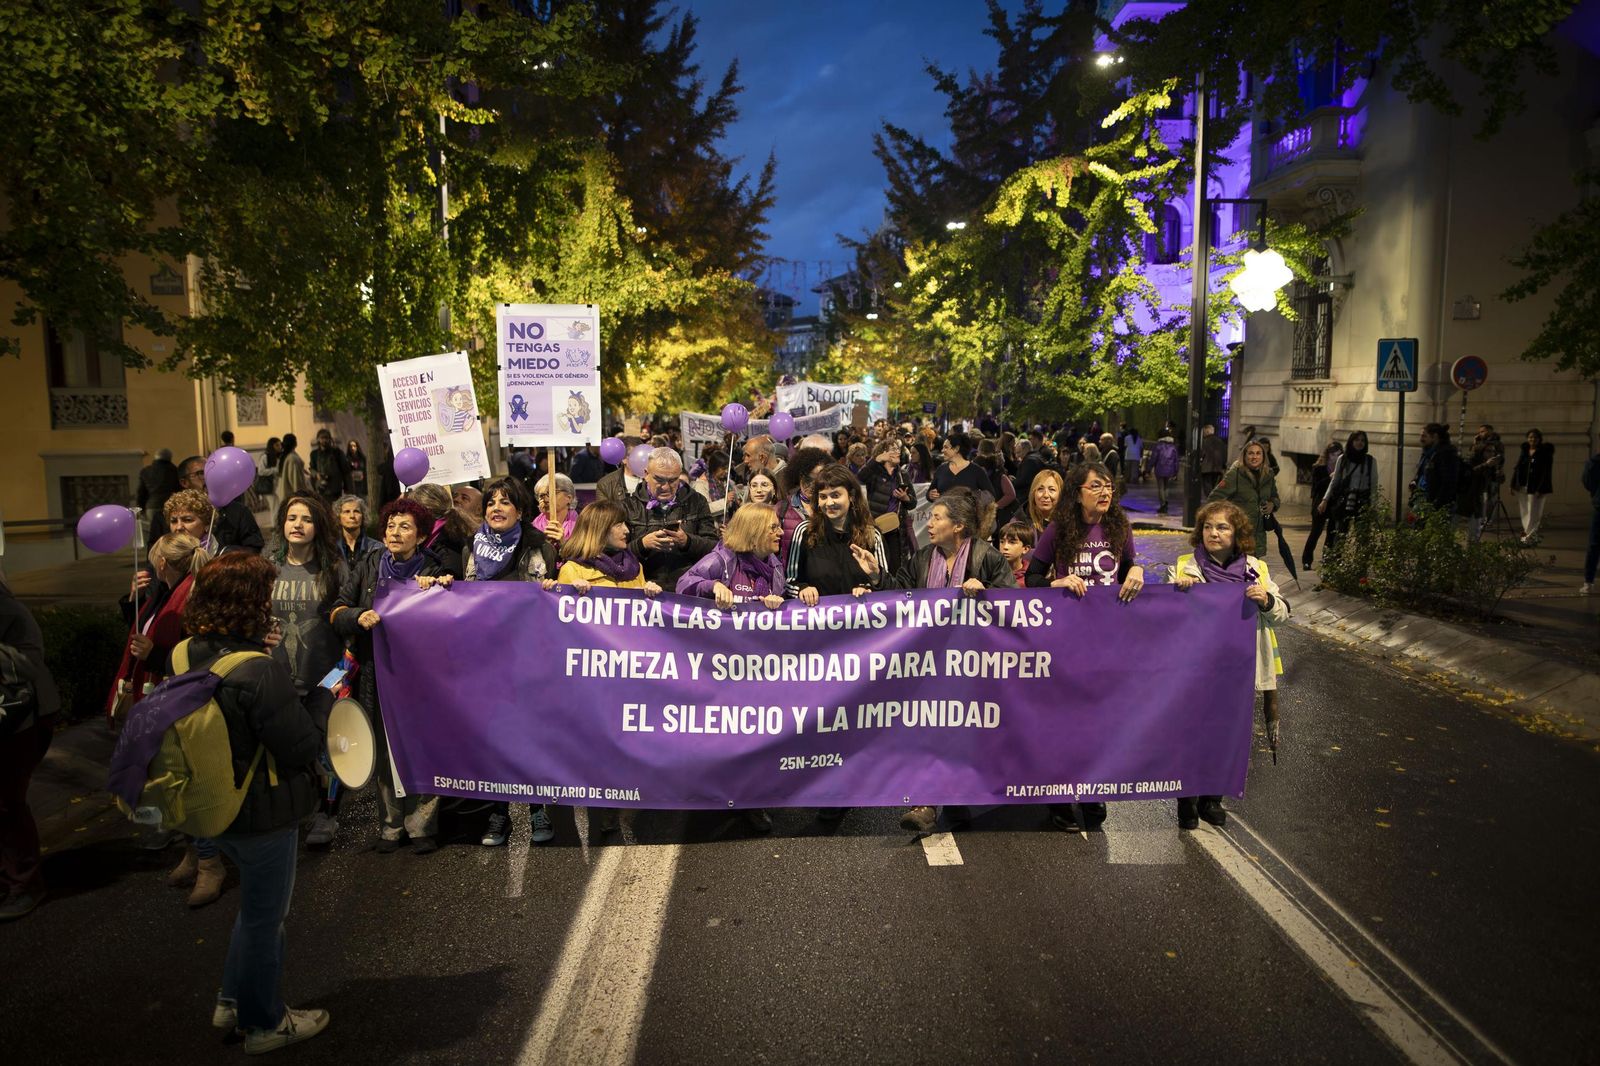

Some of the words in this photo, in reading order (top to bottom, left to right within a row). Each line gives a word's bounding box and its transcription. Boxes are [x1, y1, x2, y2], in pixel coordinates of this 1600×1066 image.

[509, 322, 544, 339] NO
[506, 343, 560, 352] TENGAS
[508, 358, 560, 369] MIEDO
[392, 374, 419, 389] ACCESO
[419, 370, 434, 384] EN
[394, 389, 407, 401] LSE
[408, 388, 415, 398] A
[414, 386, 428, 398] LOS
[396, 397, 432, 413] SERVICIOS
[401, 425, 411, 437] DE
[404, 432, 438, 449] ATENCIÓN
[422, 444, 445, 457] MUJER
[558, 596, 665, 628] CONTRA
[673, 604, 722, 630] LAS
[732, 602, 888, 631] VIOLENCIAS
[895, 598, 1053, 628] MACHISTAS:
[566, 648, 679, 680] FIRMEZA
[687, 652, 704, 680] Y
[711, 653, 861, 682] SORORIDAD
[869, 650, 937, 681] PARA
[945, 649, 1052, 679] ROMPER
[622, 703, 655, 732] EL
[662, 704, 783, 735] SILENCIO
[791, 706, 810, 734] Y
[817, 706, 849, 733] LA
[856, 700, 1001, 729] IMPUNIDAD
[779, 753, 843, 770] 25N-2024
[434, 776, 476, 791] ESPACIO
[478, 780, 534, 796] FEMINISMO
[536, 786, 586, 799] UNITARIO
[588, 787, 602, 799] DE
[604, 788, 641, 801] GRANÁ
[1006, 783, 1074, 797] PLATAFORMA
[1076, 782, 1118, 796] 8M/25N
[1120, 782, 1133, 794] DE
[1135, 780, 1182, 793] GRANADA
